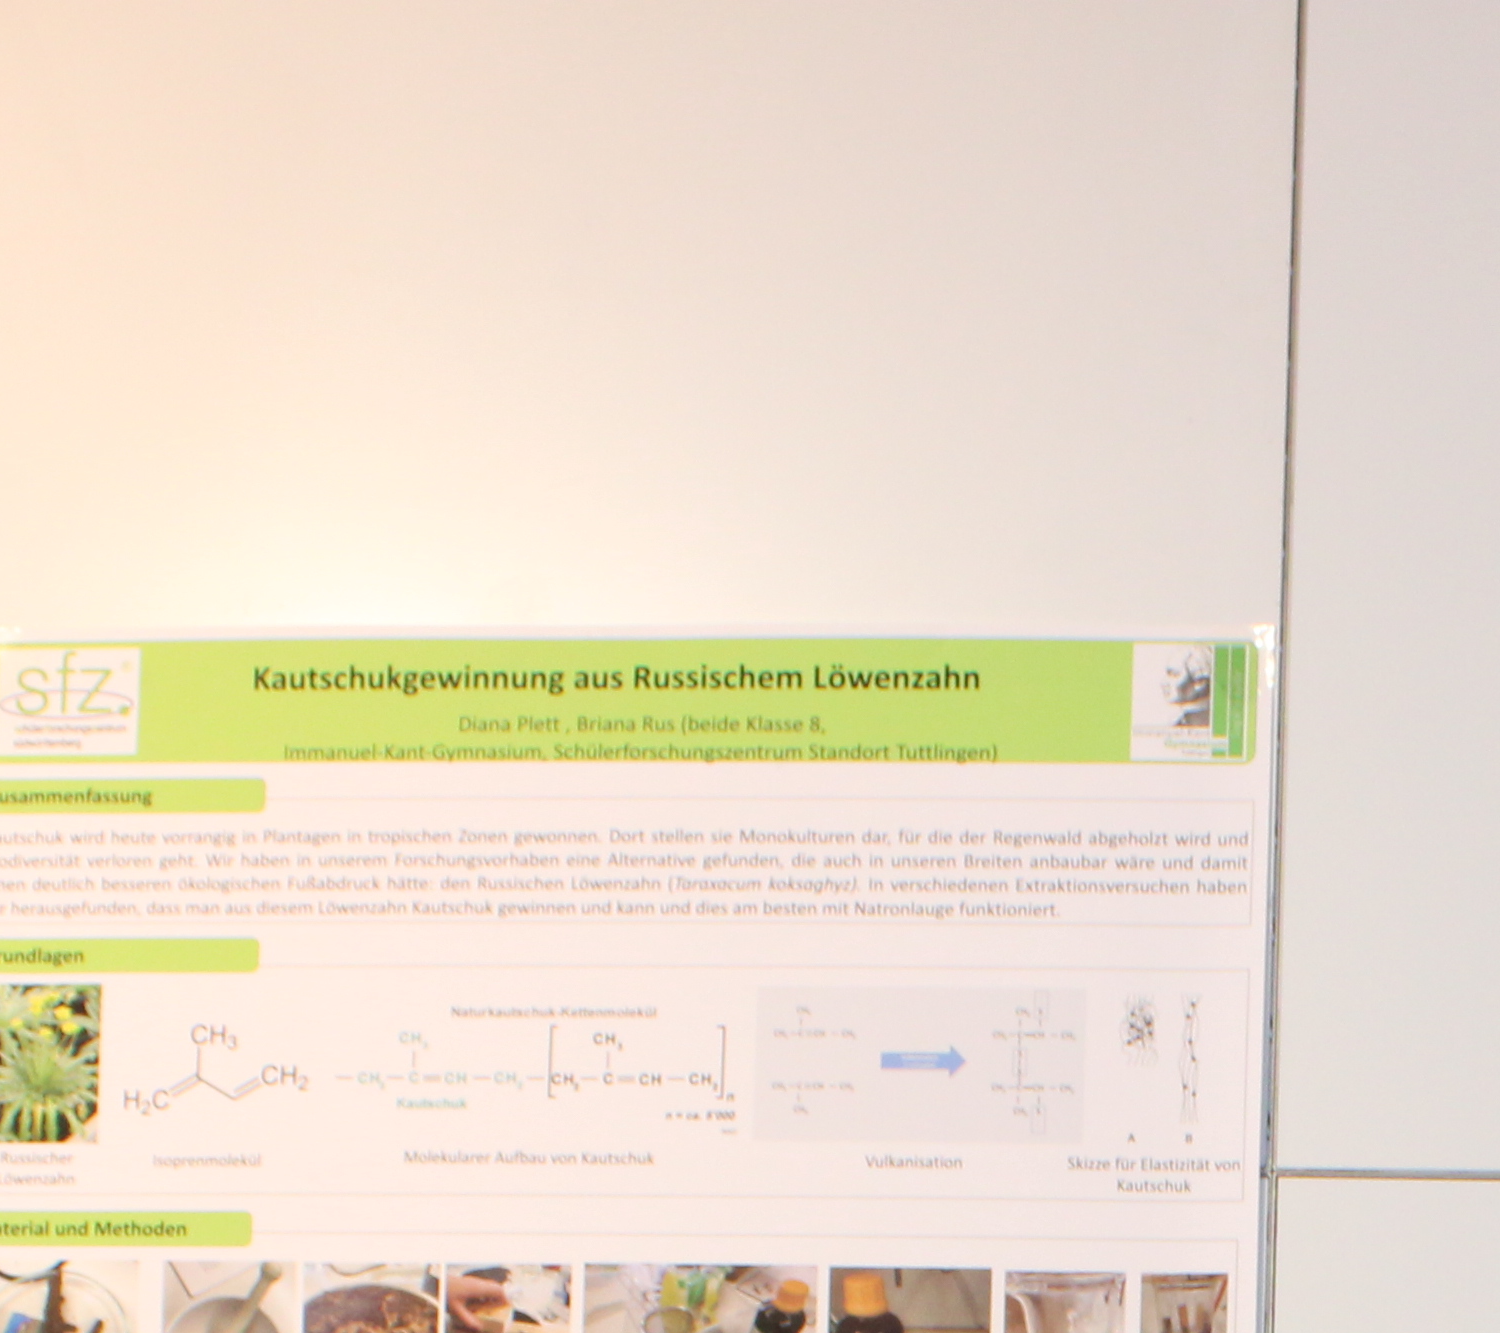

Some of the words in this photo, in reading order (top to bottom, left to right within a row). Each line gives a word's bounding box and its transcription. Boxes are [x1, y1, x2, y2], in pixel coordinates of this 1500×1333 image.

[254, 665, 564, 696] Kautschukgewinnung
[575, 672, 623, 690] aus
[634, 664, 803, 690] Russischem
[814, 664, 980, 690] Löwenzahn
[459, 716, 512, 733] Diana
[517, 716, 560, 733] Plett
[577, 716, 636, 733] Briana
[642, 717, 676, 733] Rus
[681, 715, 740, 736] (beide
[746, 715, 804, 734] Klasse
[809, 716, 826, 735] 8,
[284, 743, 548, 762] Immanuel-Kant-Gymnasium,
[553, 743, 804, 762] Schülerforschungszentrum
[808, 743, 892, 761] Standort
[897, 744, 1000, 763] Tuttlingen)
[865, 1155, 963, 1169] Vulkanisation
[55, 1221, 90, 1237] und
[94, 1220, 188, 1237] Methoden
